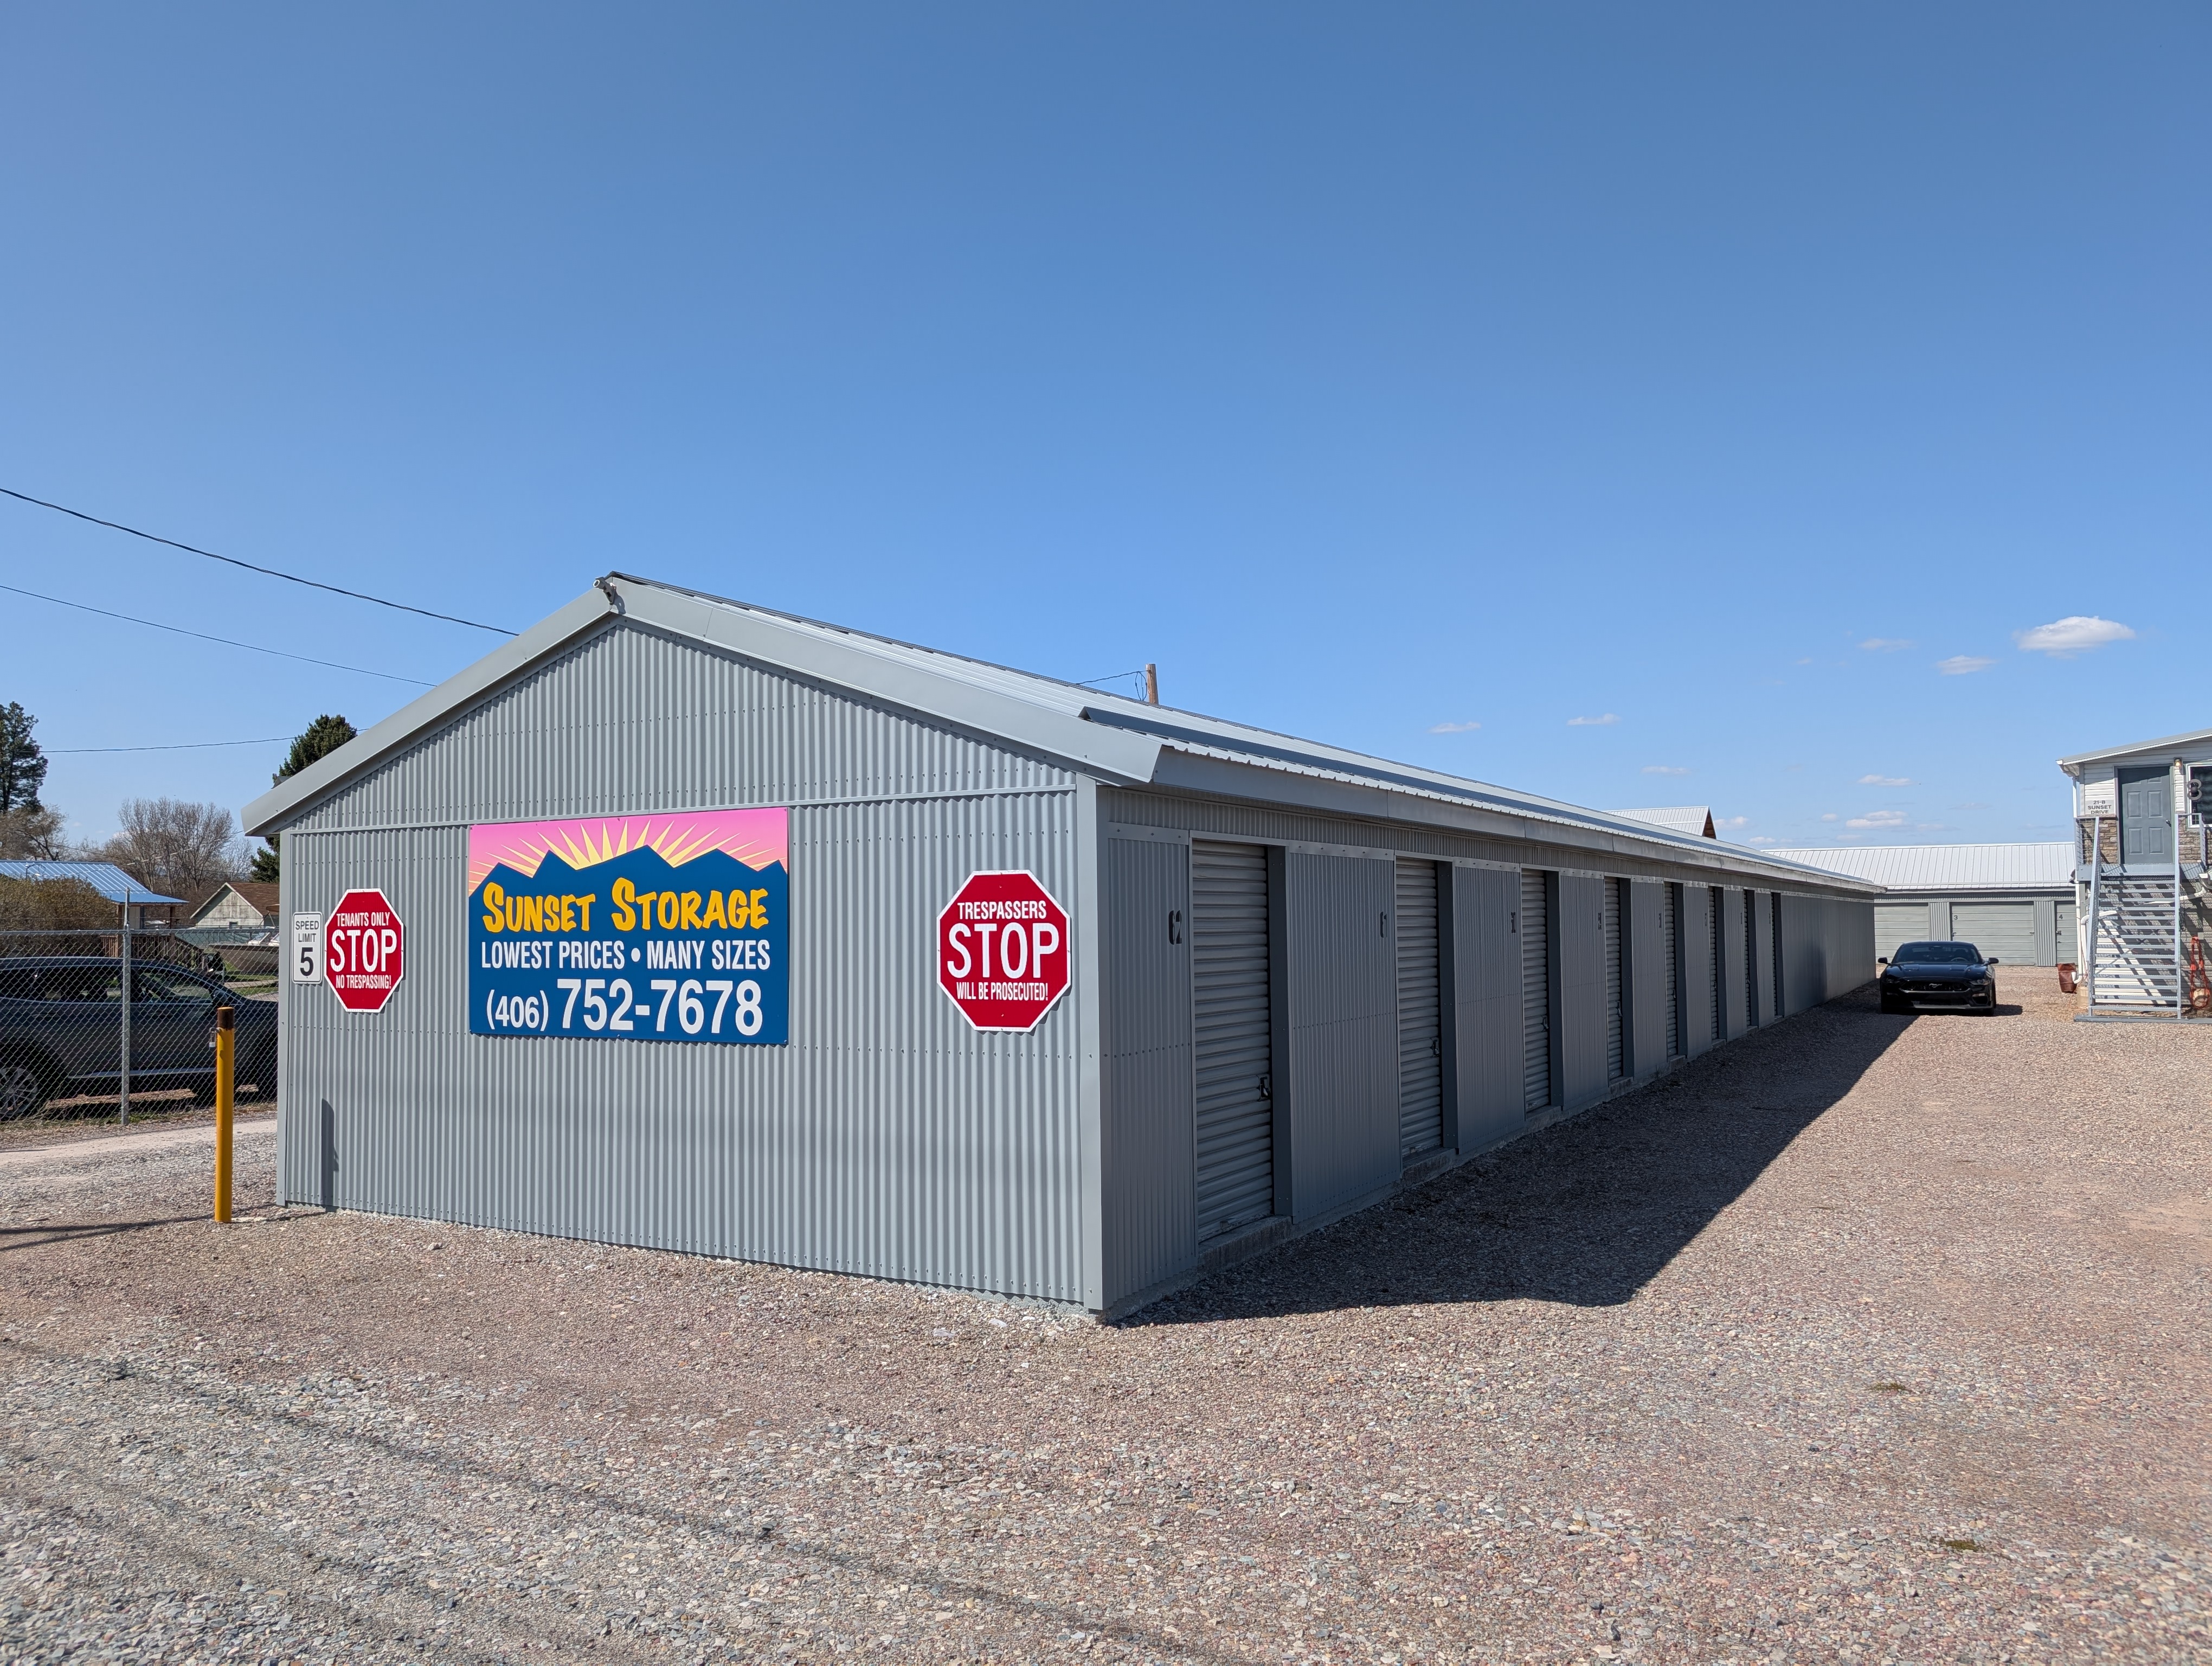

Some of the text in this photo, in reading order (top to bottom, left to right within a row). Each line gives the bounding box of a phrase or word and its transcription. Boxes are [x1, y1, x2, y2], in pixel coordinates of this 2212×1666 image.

[483, 877, 769, 933] SUNSET STORAGE
[957, 900, 1046, 919] TRESPASSERS
[295, 920, 319, 930] SPEED
[336, 912, 390, 927] TENANTS ONLY
[298, 933, 316, 943] LIMIT
[330, 928, 397, 972] STOP
[300, 947, 314, 976] 5
[481, 940, 770, 970] LOWEST PRICES MANY SIZES
[947, 922, 1059, 979] STOP
[336, 975, 391, 989] NO TRESPASSING!
[956, 982, 1049, 1001] WILL BE PROSECUTED!
[487, 978, 763, 1036] (406) 752-7678
